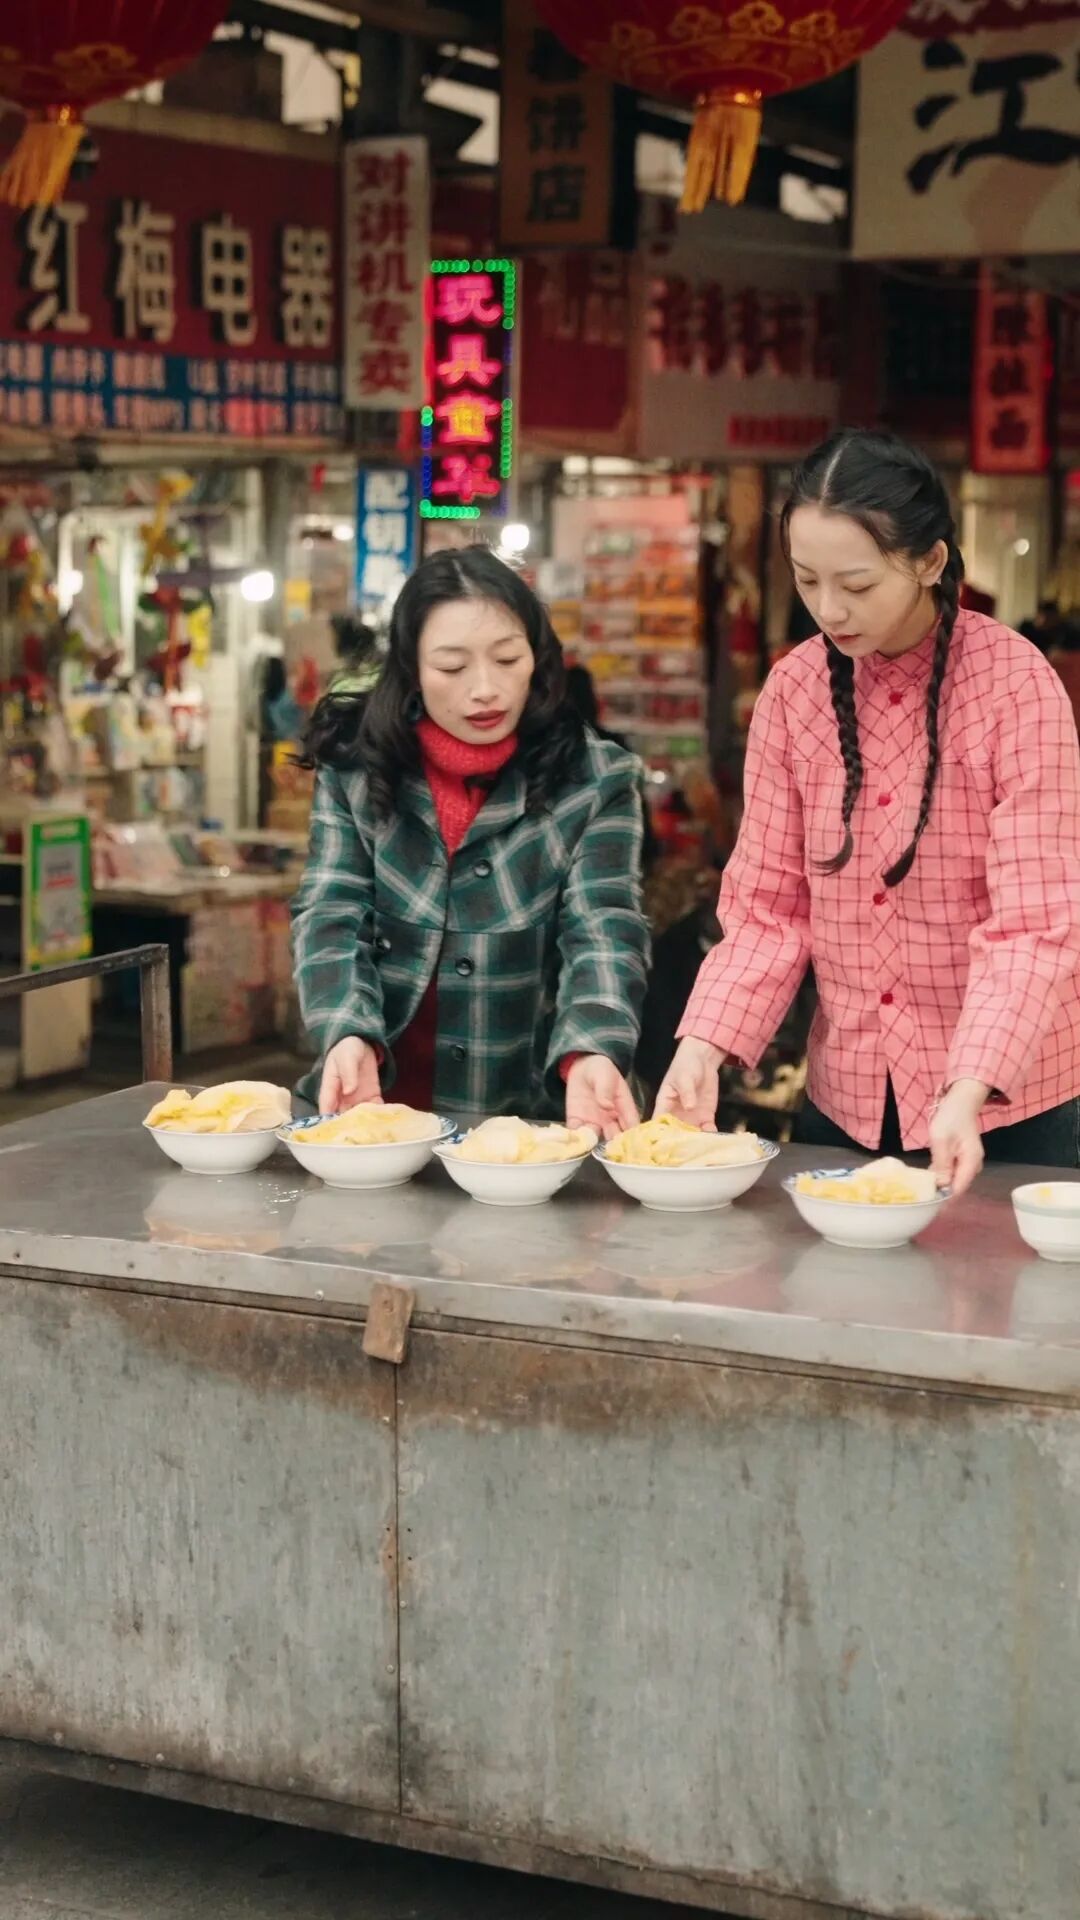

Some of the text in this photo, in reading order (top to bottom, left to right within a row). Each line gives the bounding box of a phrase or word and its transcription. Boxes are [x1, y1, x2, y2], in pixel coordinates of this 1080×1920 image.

[906, 38, 1080, 196] 江
[28, 199, 333, 347] 红梅电器
[356, 150, 416, 396] 对讲机专卖
